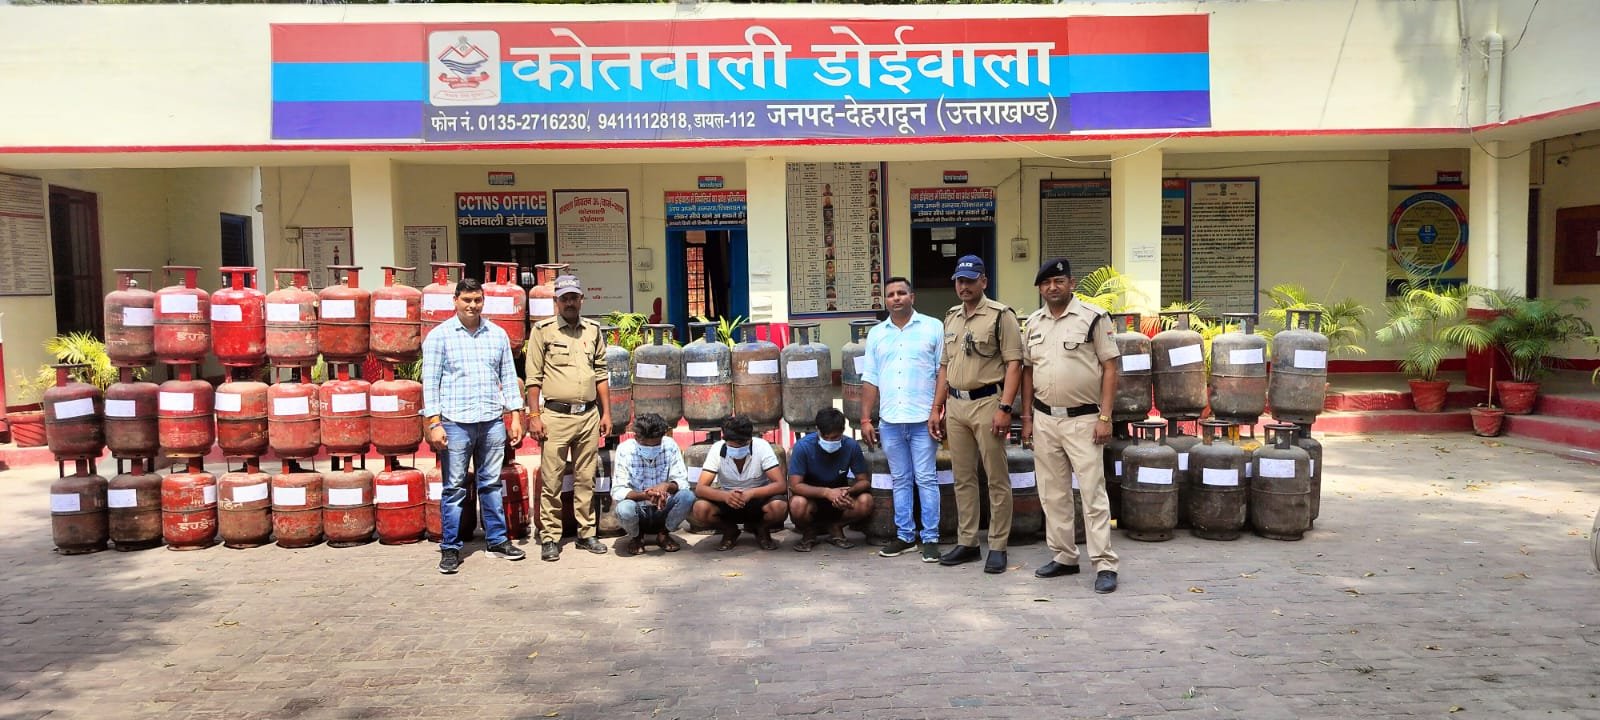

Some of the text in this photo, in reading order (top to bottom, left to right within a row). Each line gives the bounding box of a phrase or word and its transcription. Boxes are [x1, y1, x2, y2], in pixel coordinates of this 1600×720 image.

[510, 26, 1056, 94] कोतवाली डोईवाला
[431, 111, 458, 132] फोन
[460, 110, 474, 132] नं.
[598, 111, 691, 132] 9411112818,
[693, 111, 756, 129] डायल-112
[767, 94, 927, 134] जनपद-देहरादून
[937, 94, 1058, 131] (उत्तराखण्ड)
[458, 195, 546, 211] CCTNS OFFICE
[459, 213, 547, 227] कोतवाली डोईवाला
